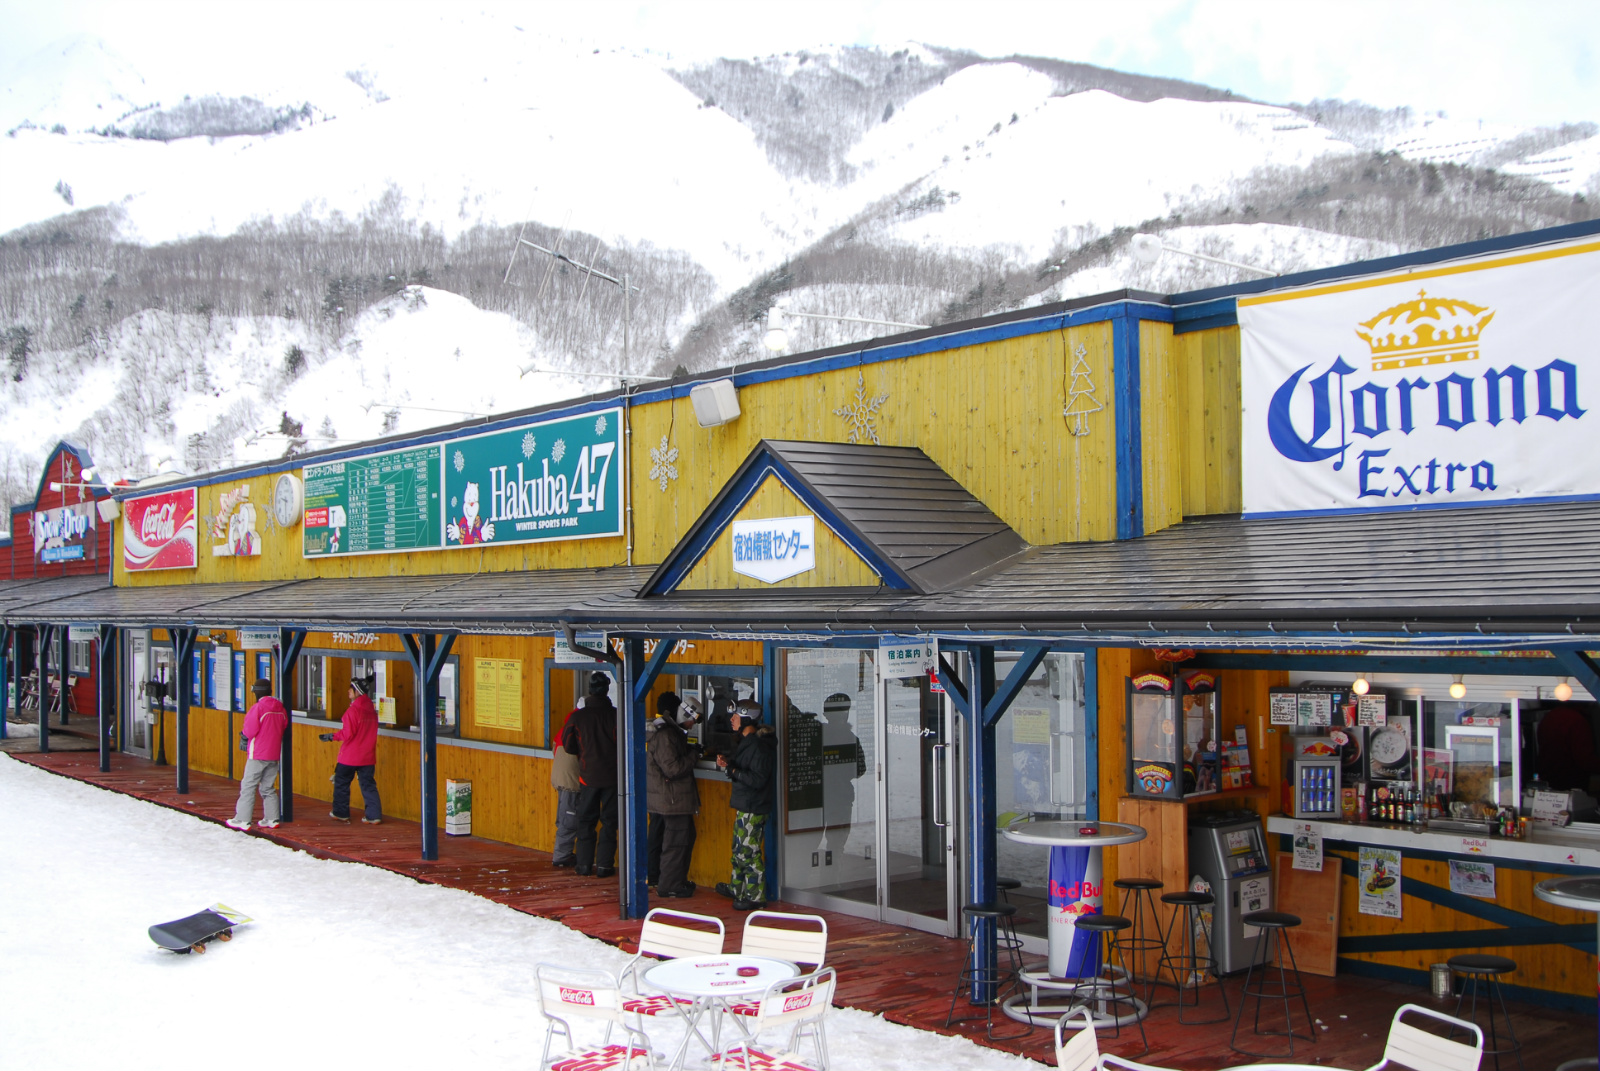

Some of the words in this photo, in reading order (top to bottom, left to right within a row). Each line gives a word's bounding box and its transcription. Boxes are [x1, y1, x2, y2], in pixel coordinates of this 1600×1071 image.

[1268, 355, 1589, 471] Corona
[1356, 448, 1499, 499] Extra
[39, 512, 62, 542] Snow
[63, 508, 88, 540] Drop
[516, 521, 537, 532] WINTER
[538, 519, 560, 529] SPORTS
[561, 517, 579, 527] PARK
[733, 530, 810, 562] 宿泊情報センター
[332, 631, 380, 645] チケットカウンター
[888, 648, 921, 660] 宿泊案内
[886, 723, 936, 737] 宿泊情報センター
[1462, 838, 1475, 846] Red
[1474, 840, 1487, 848] Bull
[1050, 879, 1080, 899] Red
[560, 988, 594, 1005] Coca-Cola
[784, 993, 812, 1012] Coca-Cola
